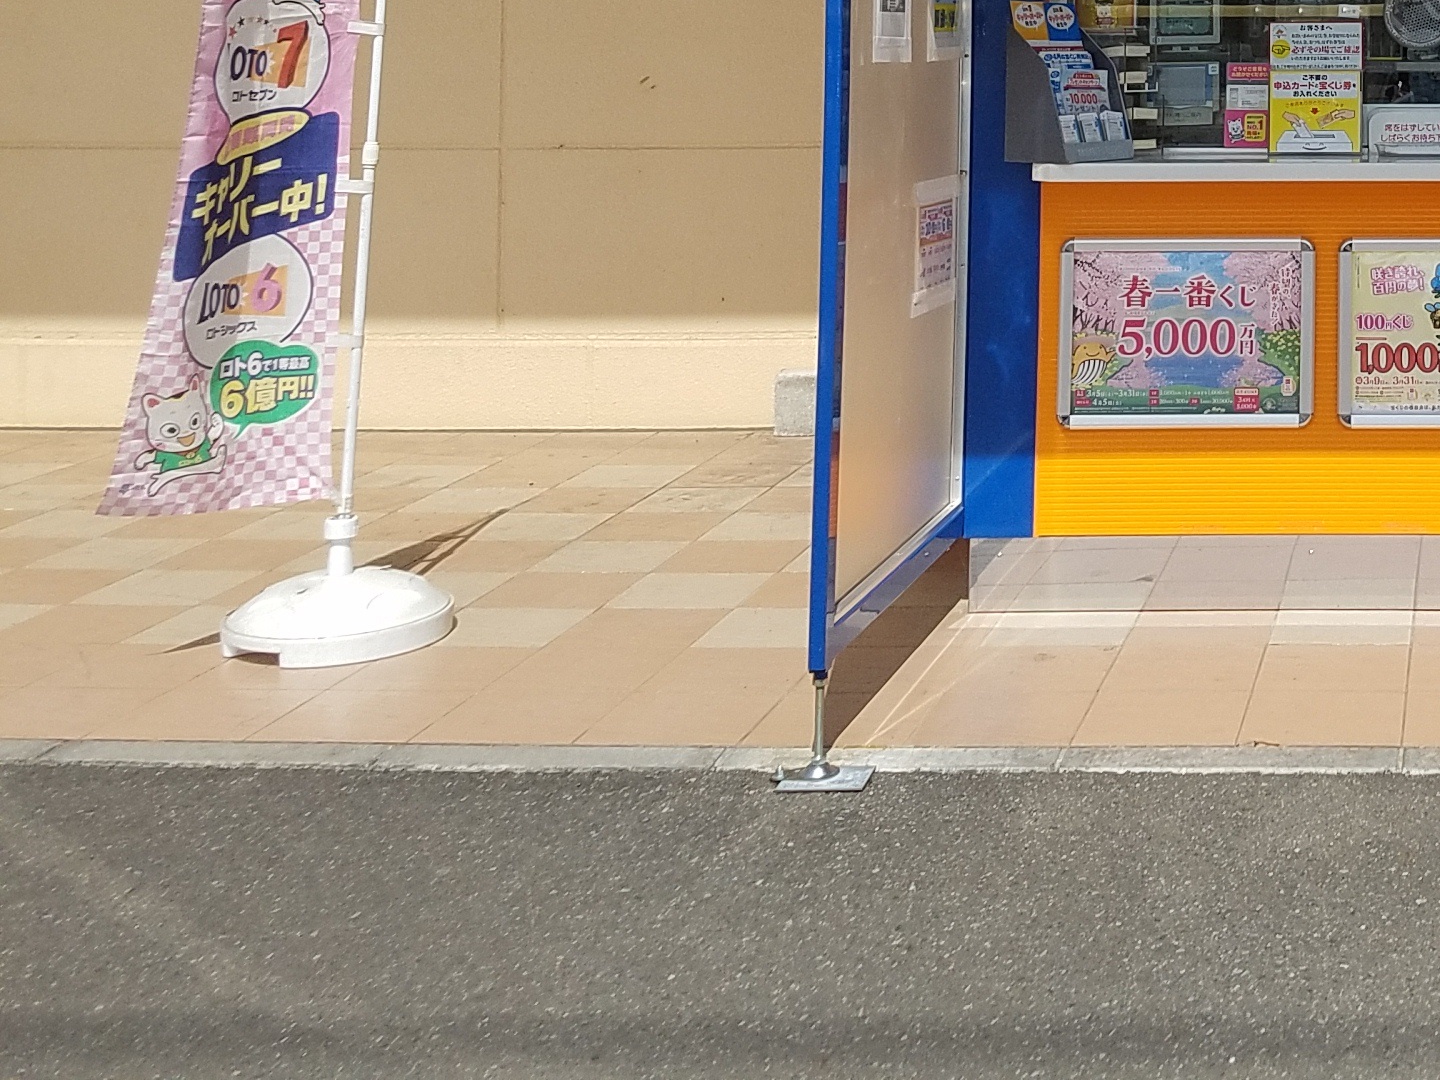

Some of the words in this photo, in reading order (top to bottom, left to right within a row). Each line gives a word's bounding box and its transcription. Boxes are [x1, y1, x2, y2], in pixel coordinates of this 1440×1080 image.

[227, 43, 267, 81] OTO
[192, 155, 283, 222] キャリー
[1119, 273, 1258, 309] 春一番くじ
[1355, 313, 1414, 332] 100円くじ
[220, 375, 315, 418] 6億円!!
